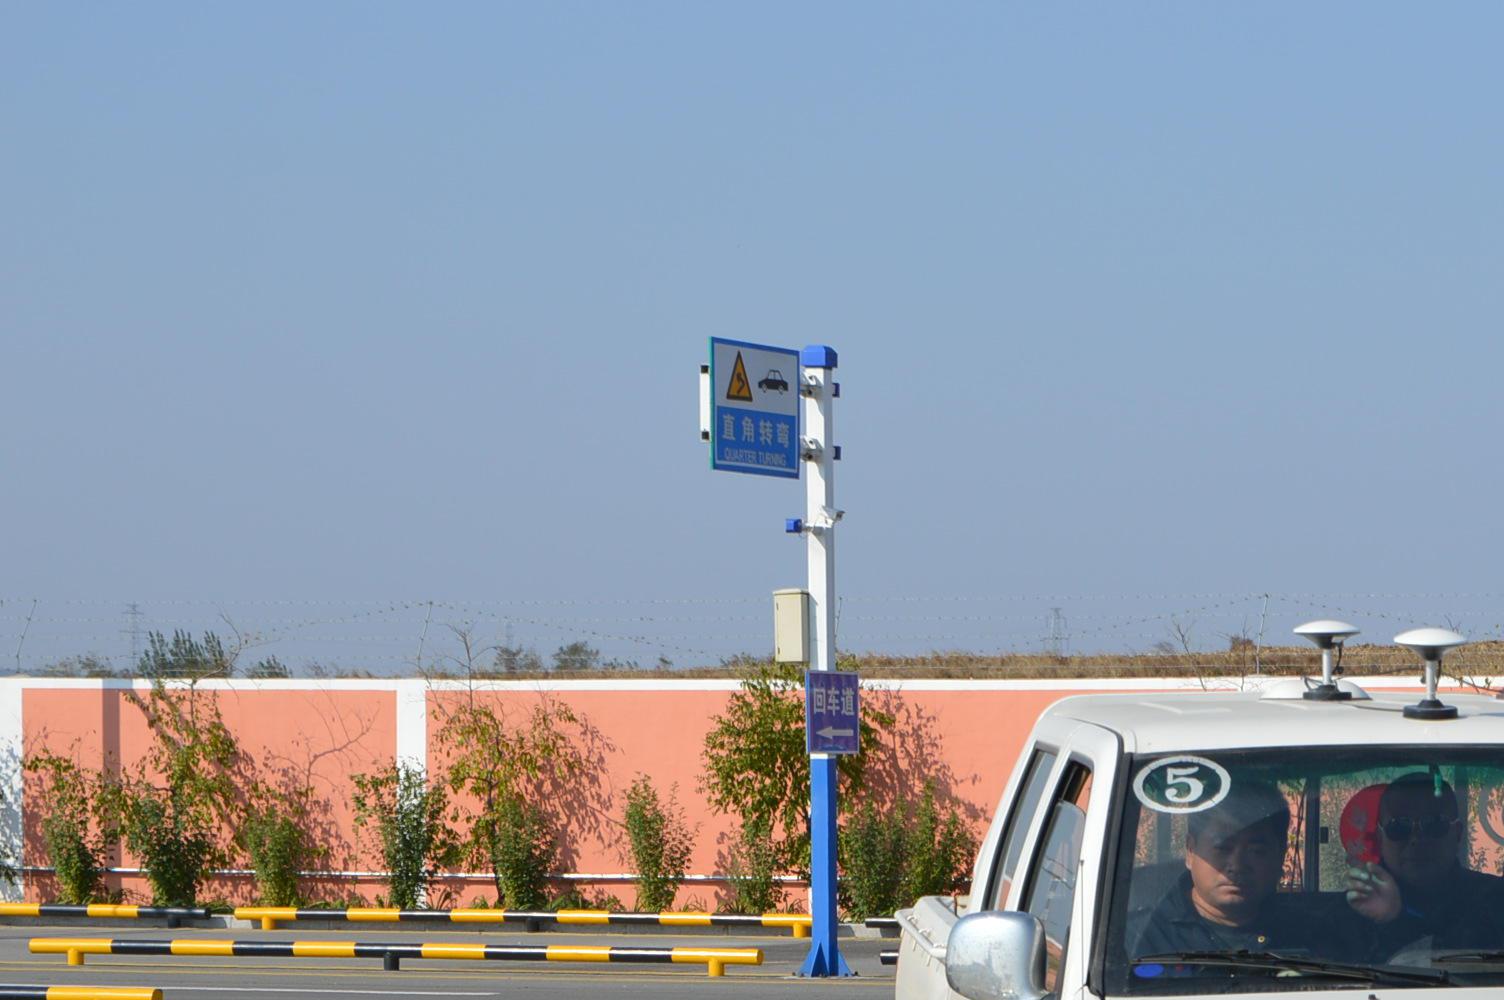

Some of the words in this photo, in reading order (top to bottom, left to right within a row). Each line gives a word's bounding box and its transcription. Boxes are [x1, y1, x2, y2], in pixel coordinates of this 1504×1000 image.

[722, 414, 789, 448] 直角转弯
[813, 686, 855, 716] 回车道
[1165, 766, 1204, 803] 5
